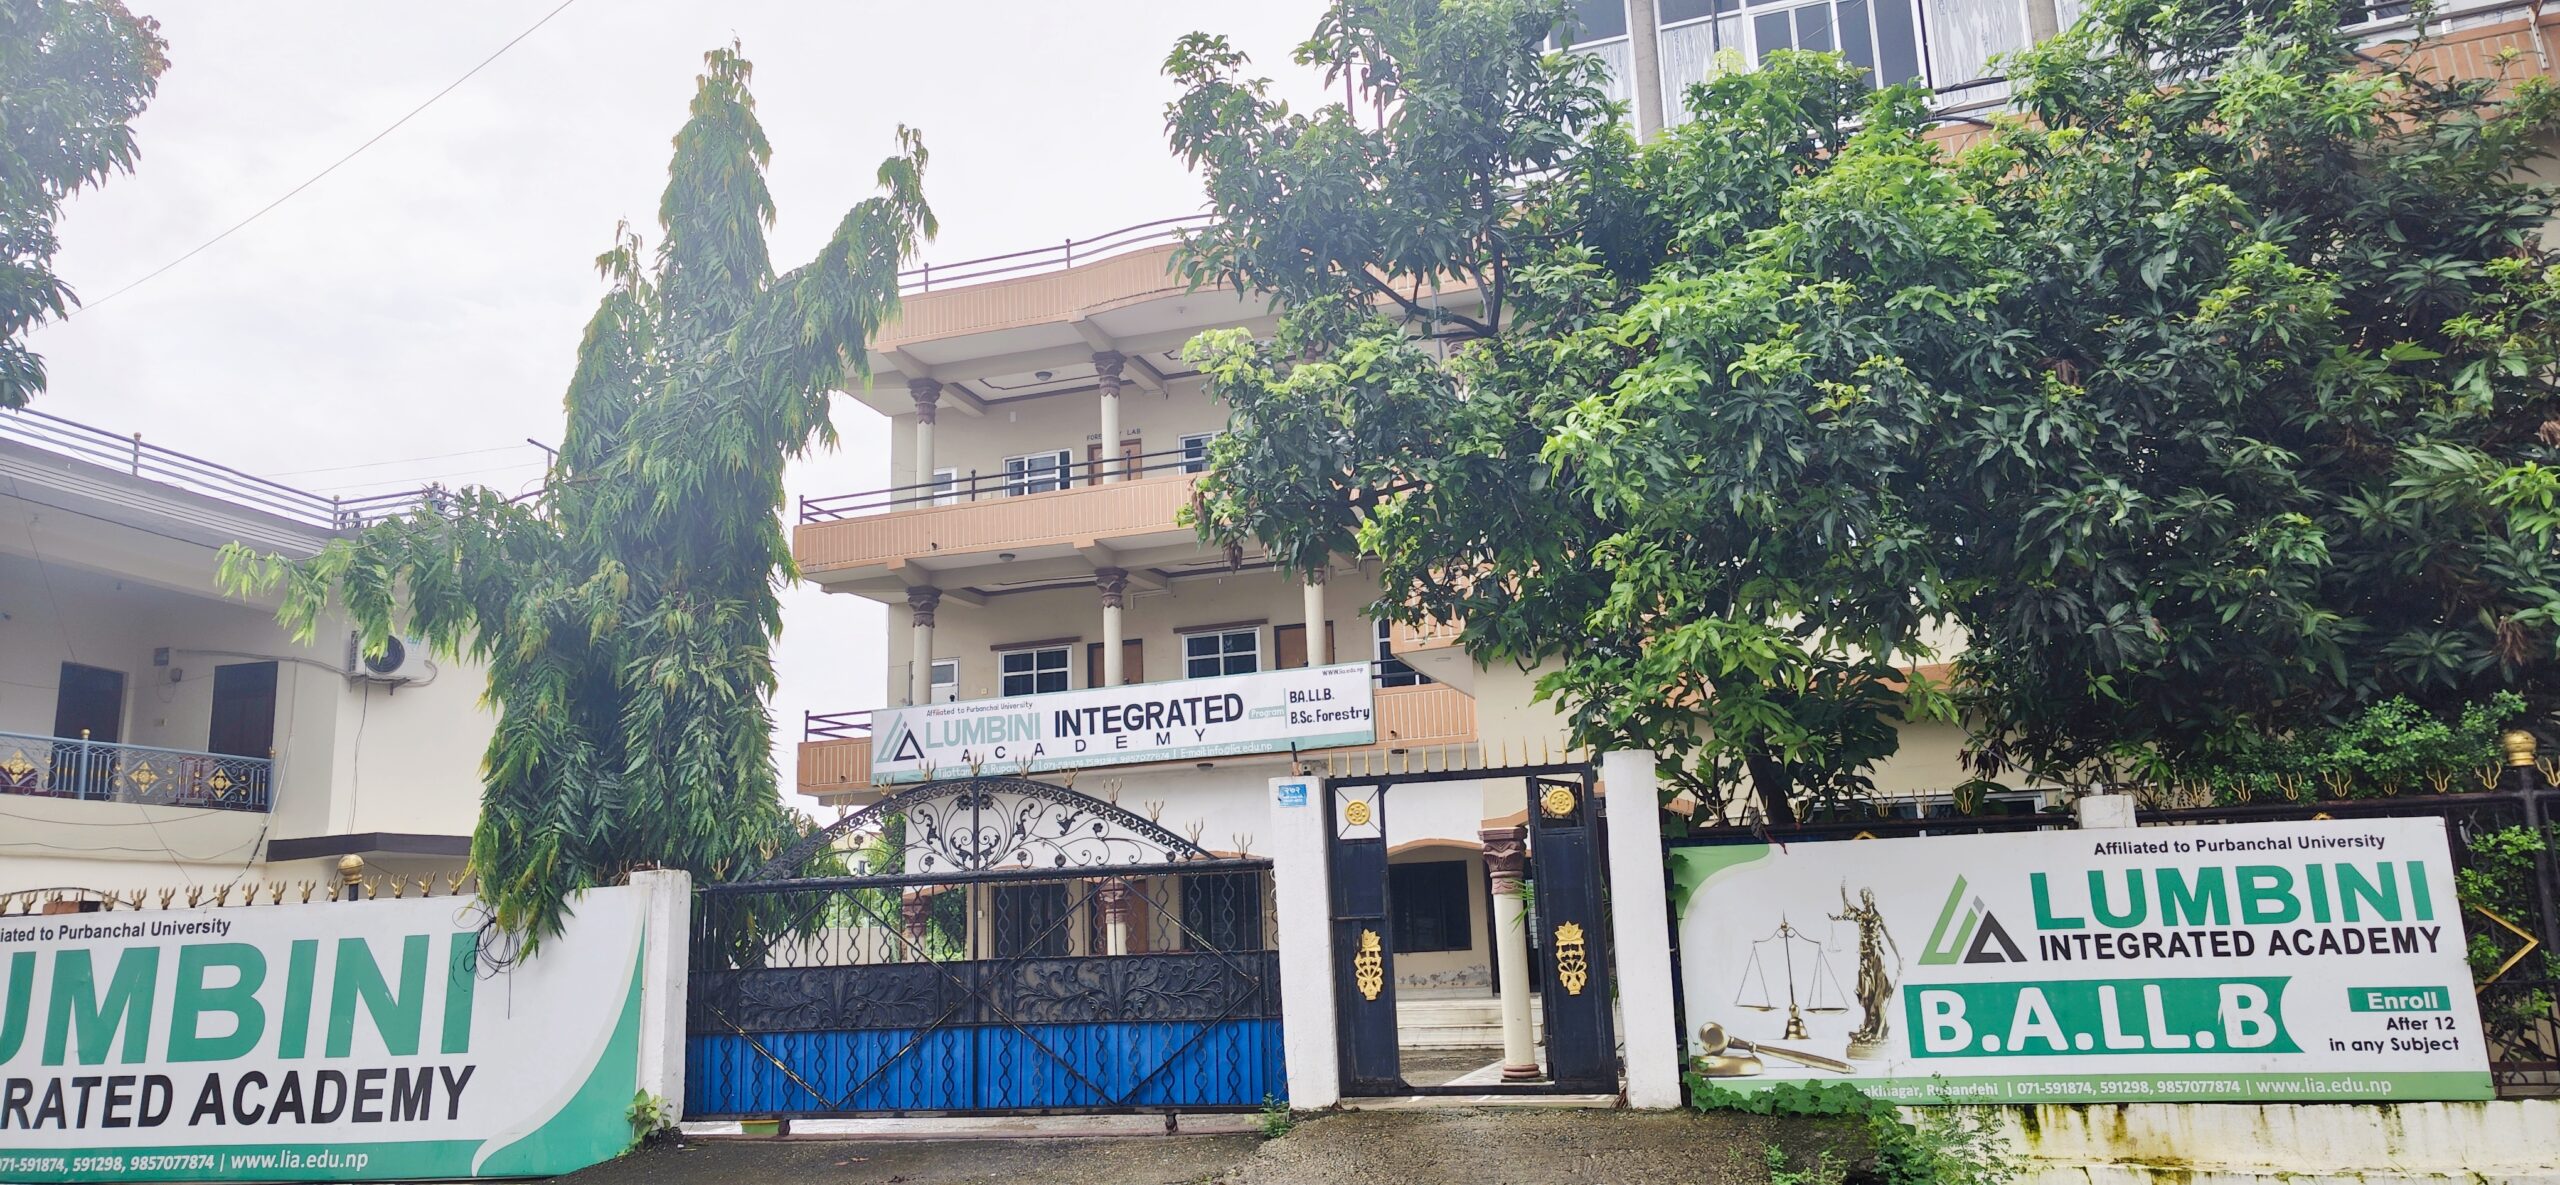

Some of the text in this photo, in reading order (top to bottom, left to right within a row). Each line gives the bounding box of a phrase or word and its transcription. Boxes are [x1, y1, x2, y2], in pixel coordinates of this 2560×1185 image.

[926, 708, 955, 717] Affiliated
[966, 704, 999, 713] Purbanchal
[1001, 701, 1033, 710] University
[1251, 707, 1285, 718] Program
[925, 693, 1244, 748] LUMBINI INTEGRATED
[2094, 834, 2386, 855] Affiliated to Purbanchal University
[2030, 860, 2435, 930] LUMBINI
[40, 929, 54, 940] to
[59, 922, 145, 940] Purbanchal
[151, 918, 231, 937] University
[2039, 926, 2441, 961] INTEGRATED ACADEMY
[2367, 992, 2439, 1010] Enroll
[1919, 983, 2277, 1053] B.A.LL.B
[2386, 1017, 2456, 1031] After 12
[2329, 1036, 2459, 1054] in any Subject
[190, 1065, 476, 1126] ACADEMY
[2017, 1081, 2097, 1096] 071-591874,
[2100, 1081, 2154, 1096] 591298,
[2157, 1080, 2241, 1094] 9857077874
[2256, 1078, 2392, 1096] www.lia.edu.np
[72, 1157, 126, 1173] 591298,
[130, 1155, 215, 1171] 9857077874
[231, 1150, 369, 1172] www.lia.edu.np
